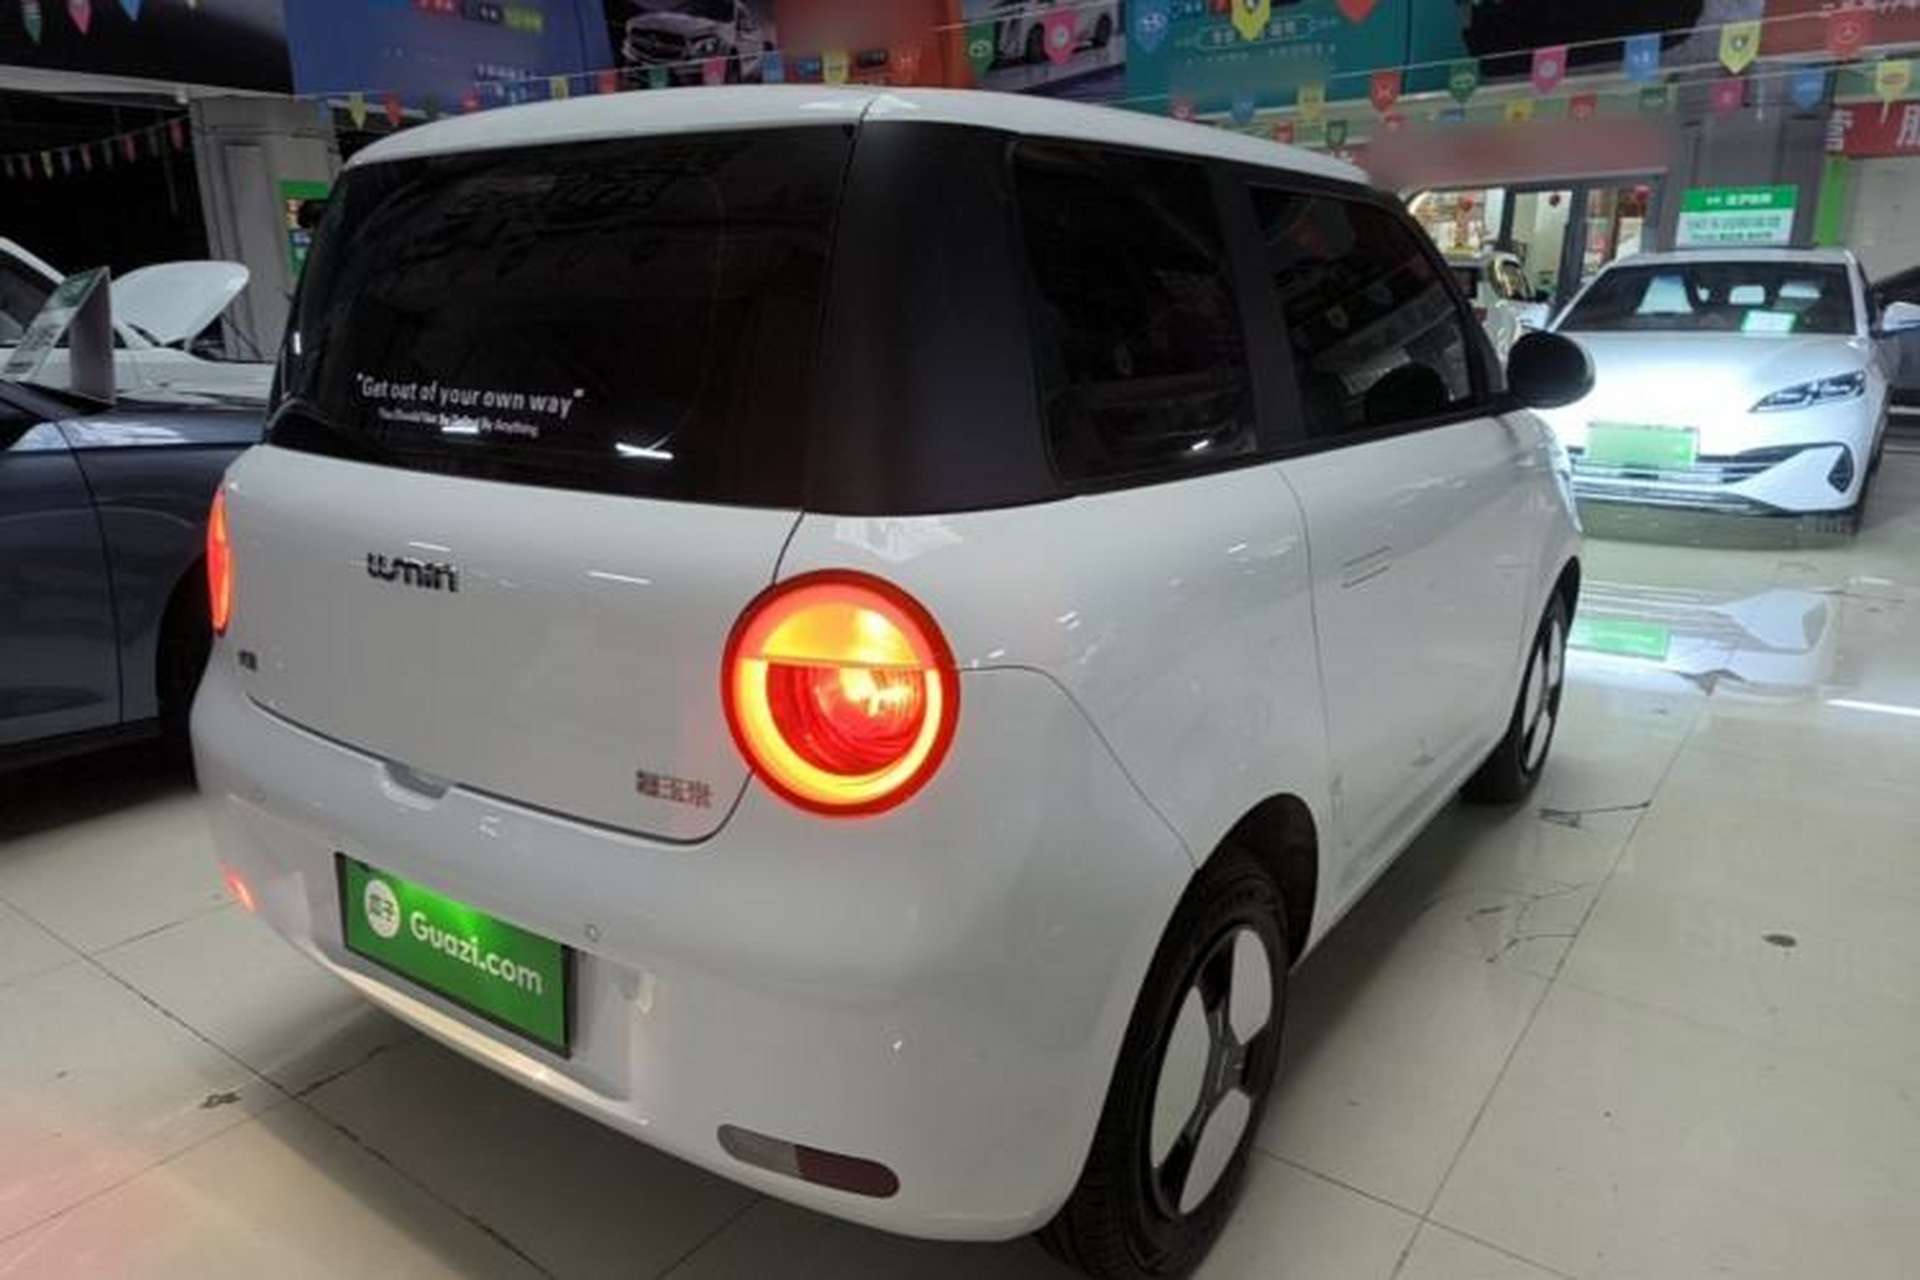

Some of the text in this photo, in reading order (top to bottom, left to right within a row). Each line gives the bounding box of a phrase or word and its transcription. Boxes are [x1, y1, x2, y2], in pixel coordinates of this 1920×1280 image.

[391, 382, 417, 401] out
[419, 380, 438, 402] of
[440, 386, 481, 407] your
[483, 389, 525, 411] own
[409, 911, 544, 996] Guazi.com
